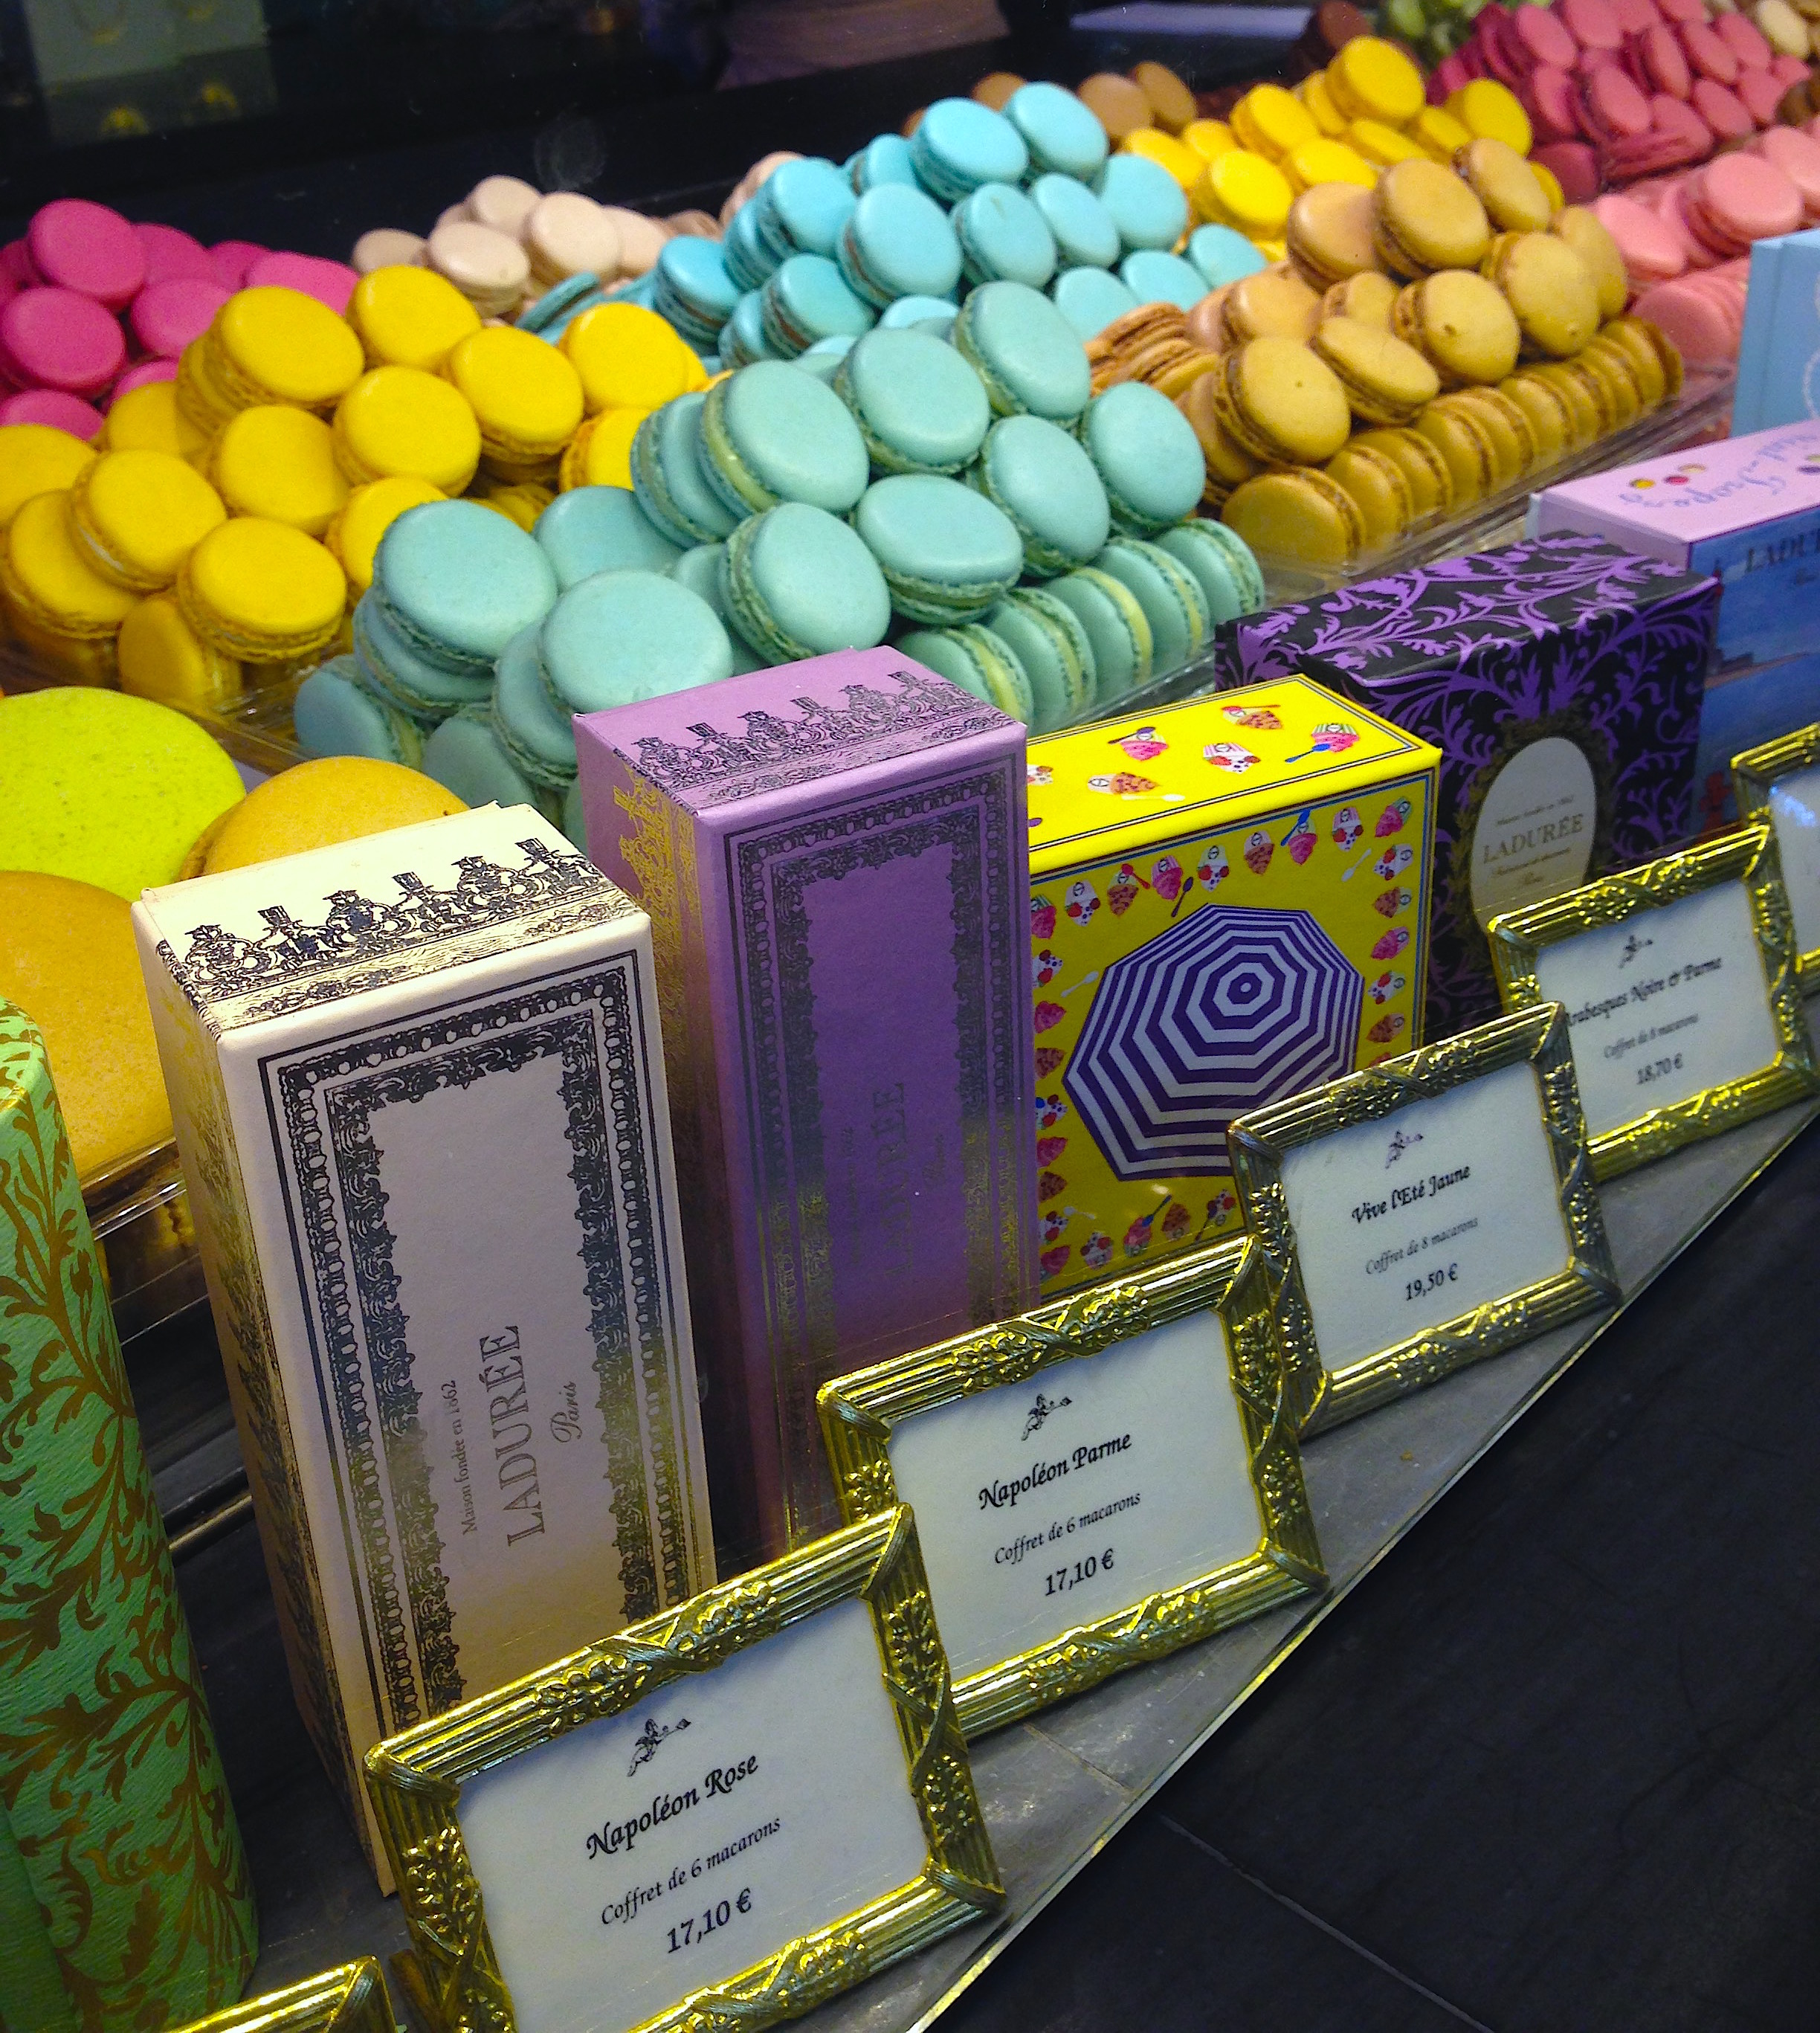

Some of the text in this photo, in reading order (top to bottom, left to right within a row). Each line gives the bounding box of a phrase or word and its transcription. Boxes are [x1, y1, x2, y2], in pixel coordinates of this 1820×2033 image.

[1566, 993, 1628, 1027] rabesques
[1352, 1201, 1387, 1223] Vive
[1429, 1166, 1471, 1197] Jaune
[1366, 1217, 1478, 1275] Coffret de 8 macarons
[1406, 1263, 1458, 1301] 19,50 €
[453, 1419, 464, 1436] en
[479, 1325, 546, 1547] LADURÉE
[550, 1381, 583, 1443] Paris
[978, 1434, 1132, 1510] Napoléon Parme
[461, 1484, 478, 1536] Maison
[995, 1492, 1140, 1565] Coffret de 6 macarons
[1045, 1548, 1114, 1597] 17,10 €
[587, 1755, 758, 1860] Napoléon Rose
[601, 1818, 781, 1924] Coffret de 6 macarons
[667, 1887, 752, 1953] 17,10 €
